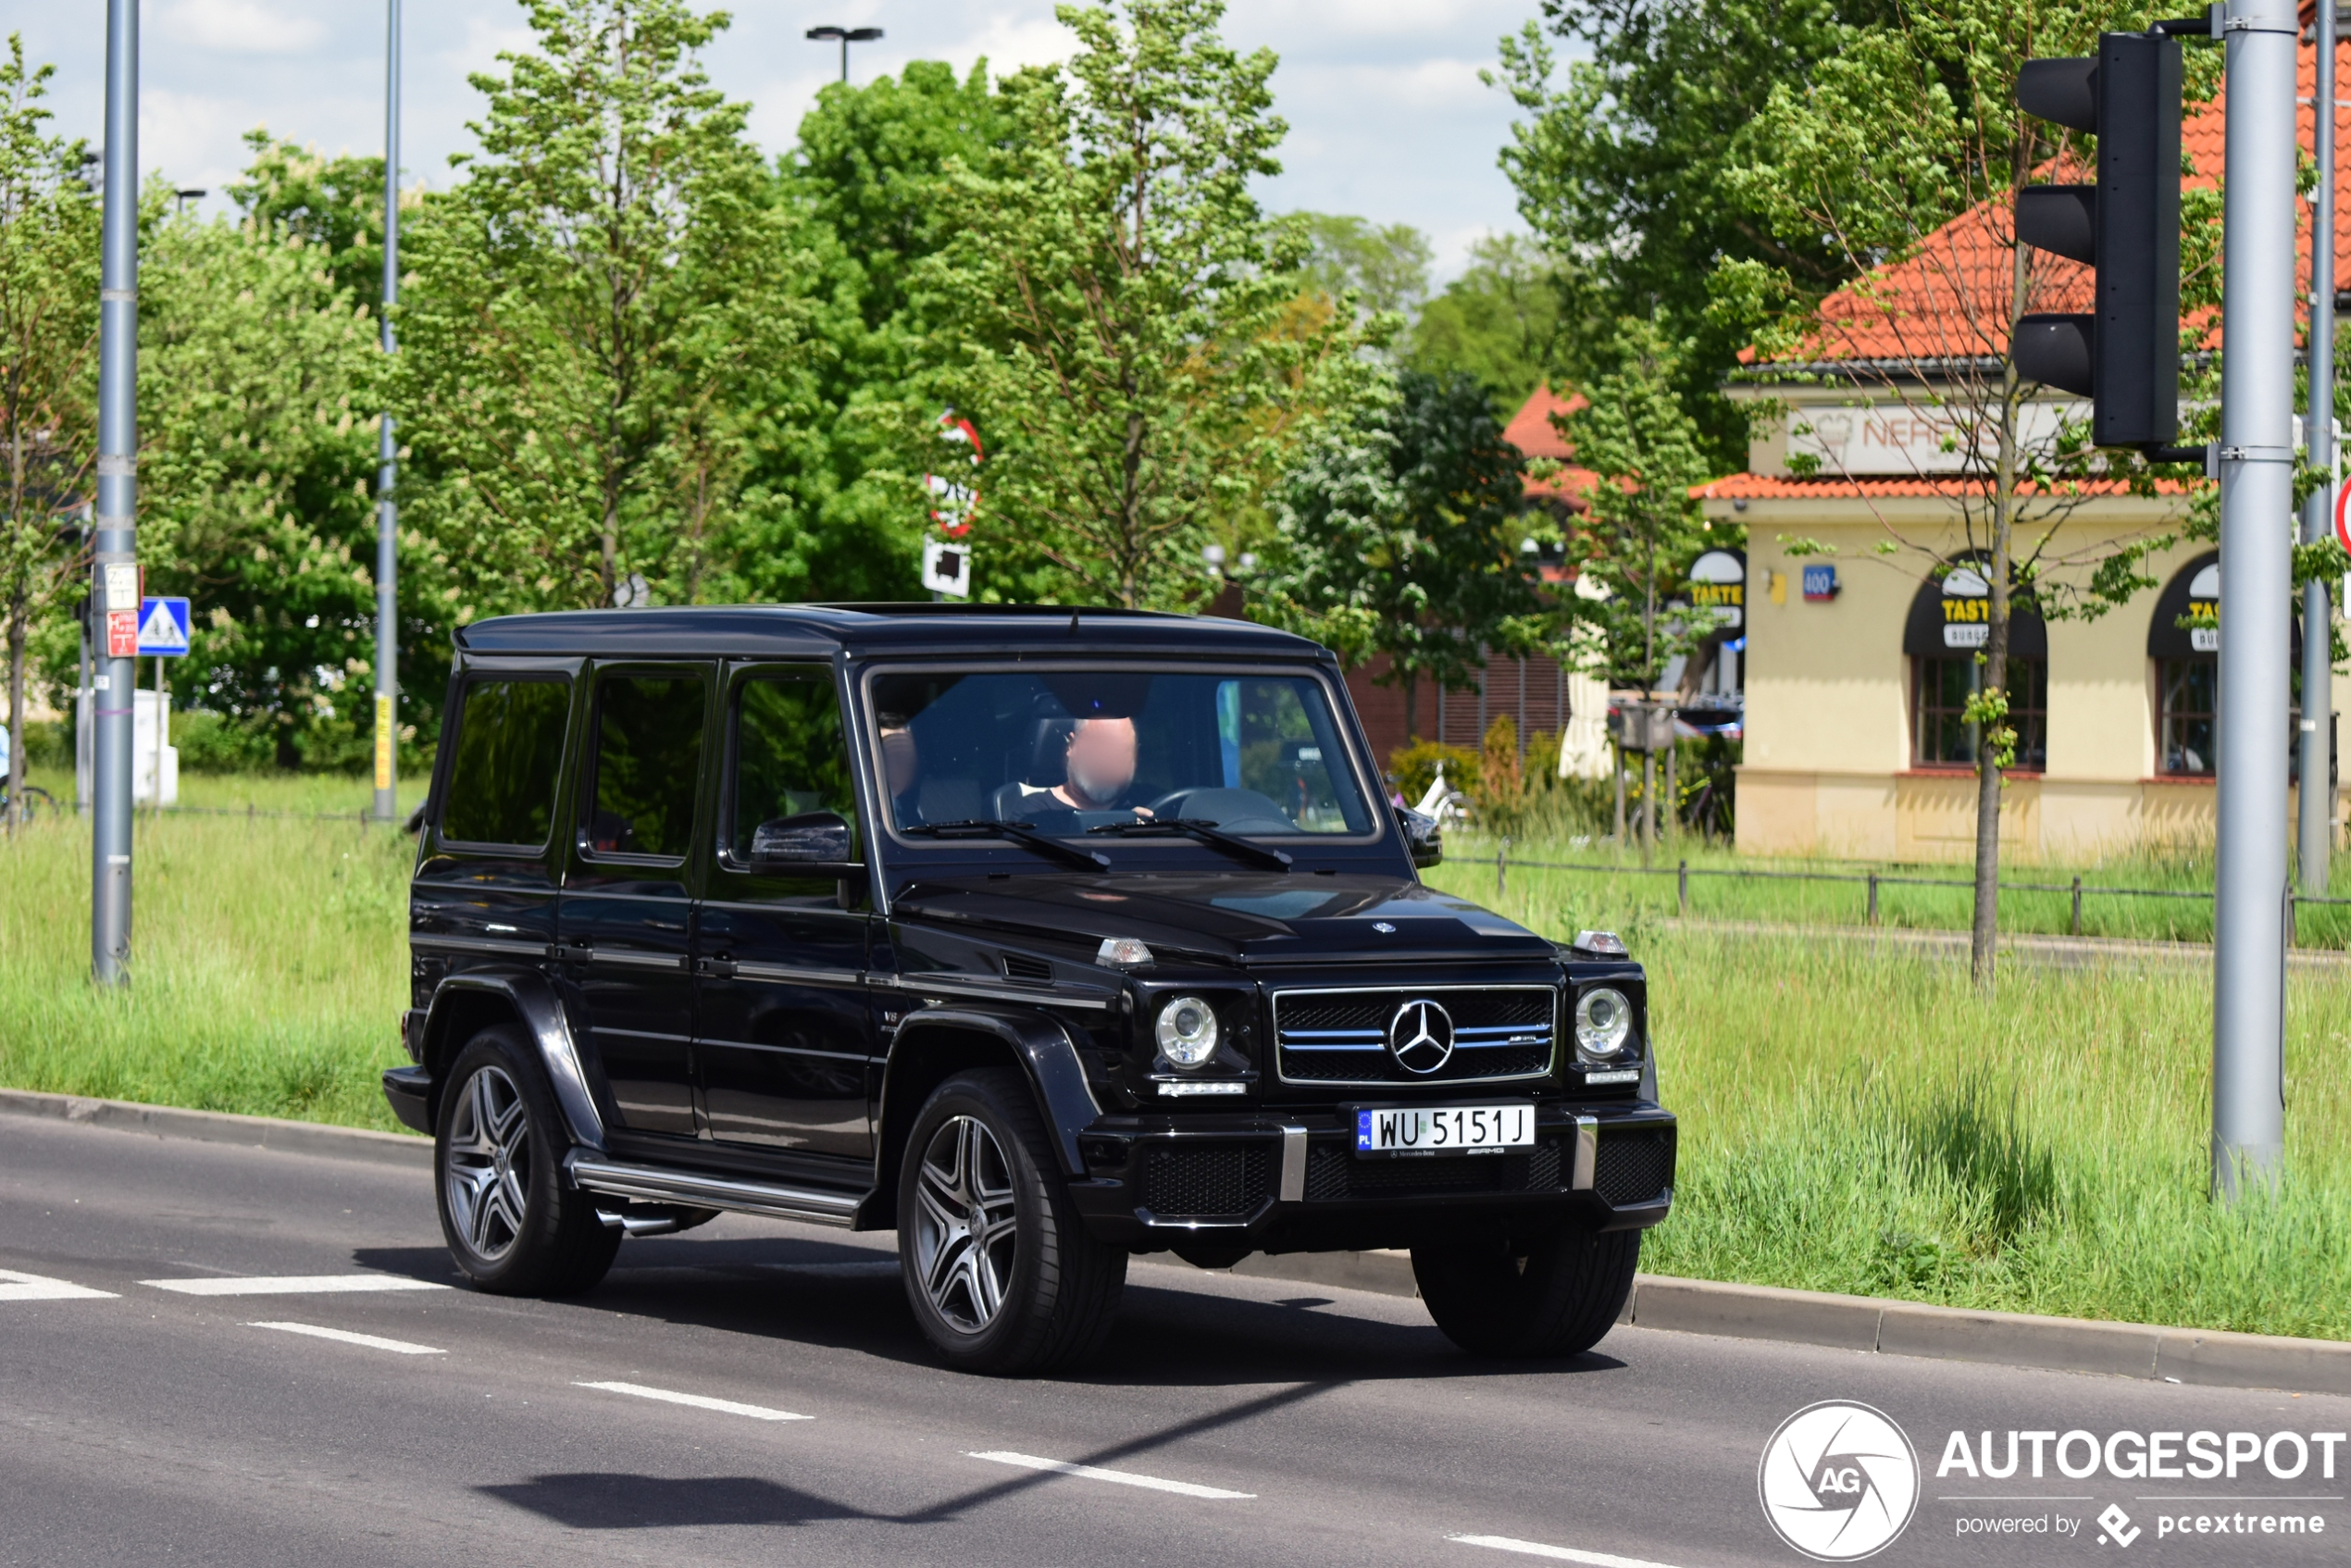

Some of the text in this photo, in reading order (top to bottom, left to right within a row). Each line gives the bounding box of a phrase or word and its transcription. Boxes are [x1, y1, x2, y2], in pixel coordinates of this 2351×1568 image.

[1691, 585, 1743, 604] TASTE
[1941, 599, 1989, 622] TAST
[2189, 602, 2220, 623] TA
[1379, 1109, 1523, 1147] WU 5151J
[1359, 1135, 1371, 1145] PL
